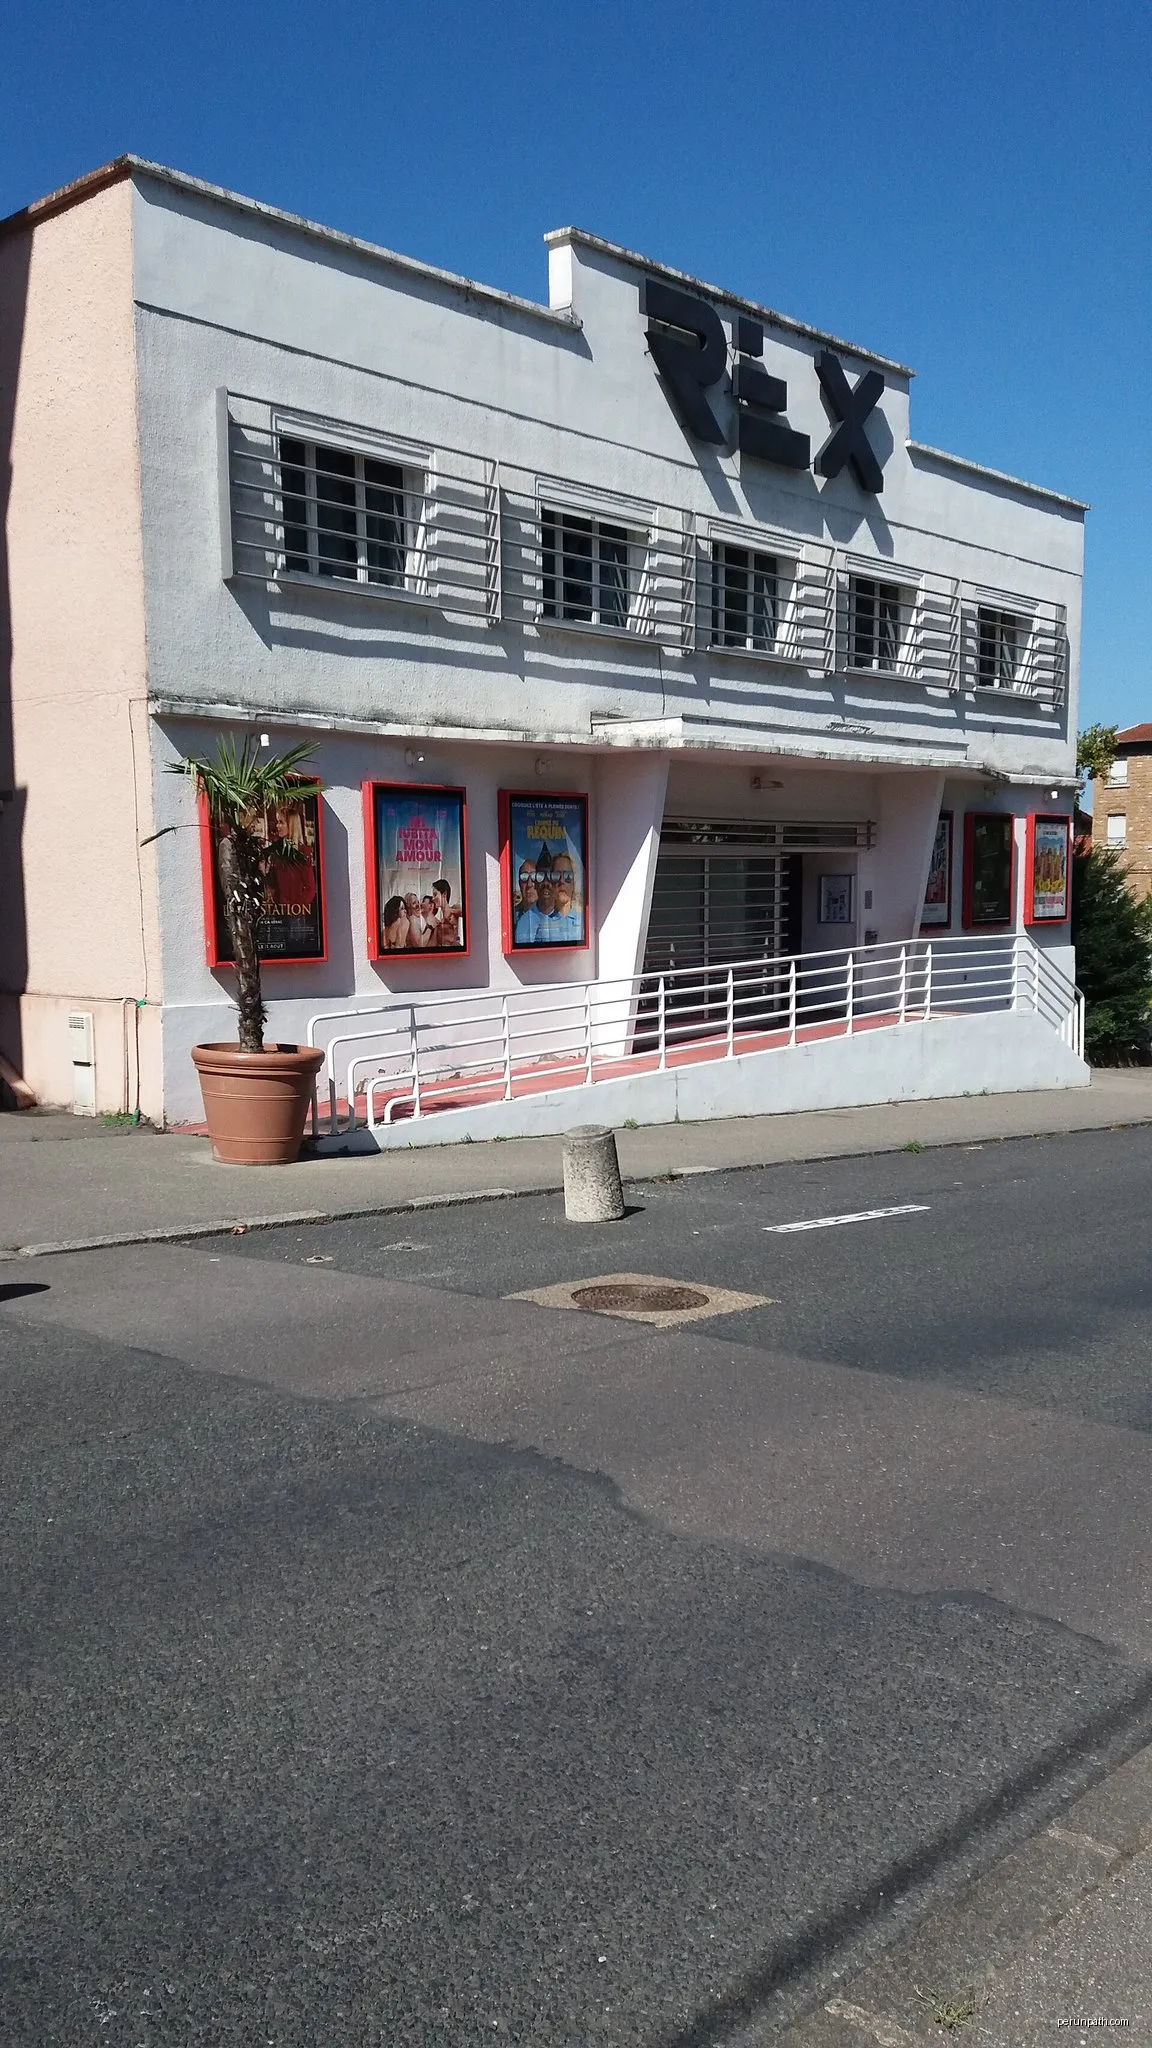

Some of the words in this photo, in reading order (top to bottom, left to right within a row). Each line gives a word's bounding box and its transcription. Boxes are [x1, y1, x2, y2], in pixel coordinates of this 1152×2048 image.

[641, 278, 884, 493] REX
[404, 839, 433, 850] MON
[396, 851, 441, 862] AMOUR
